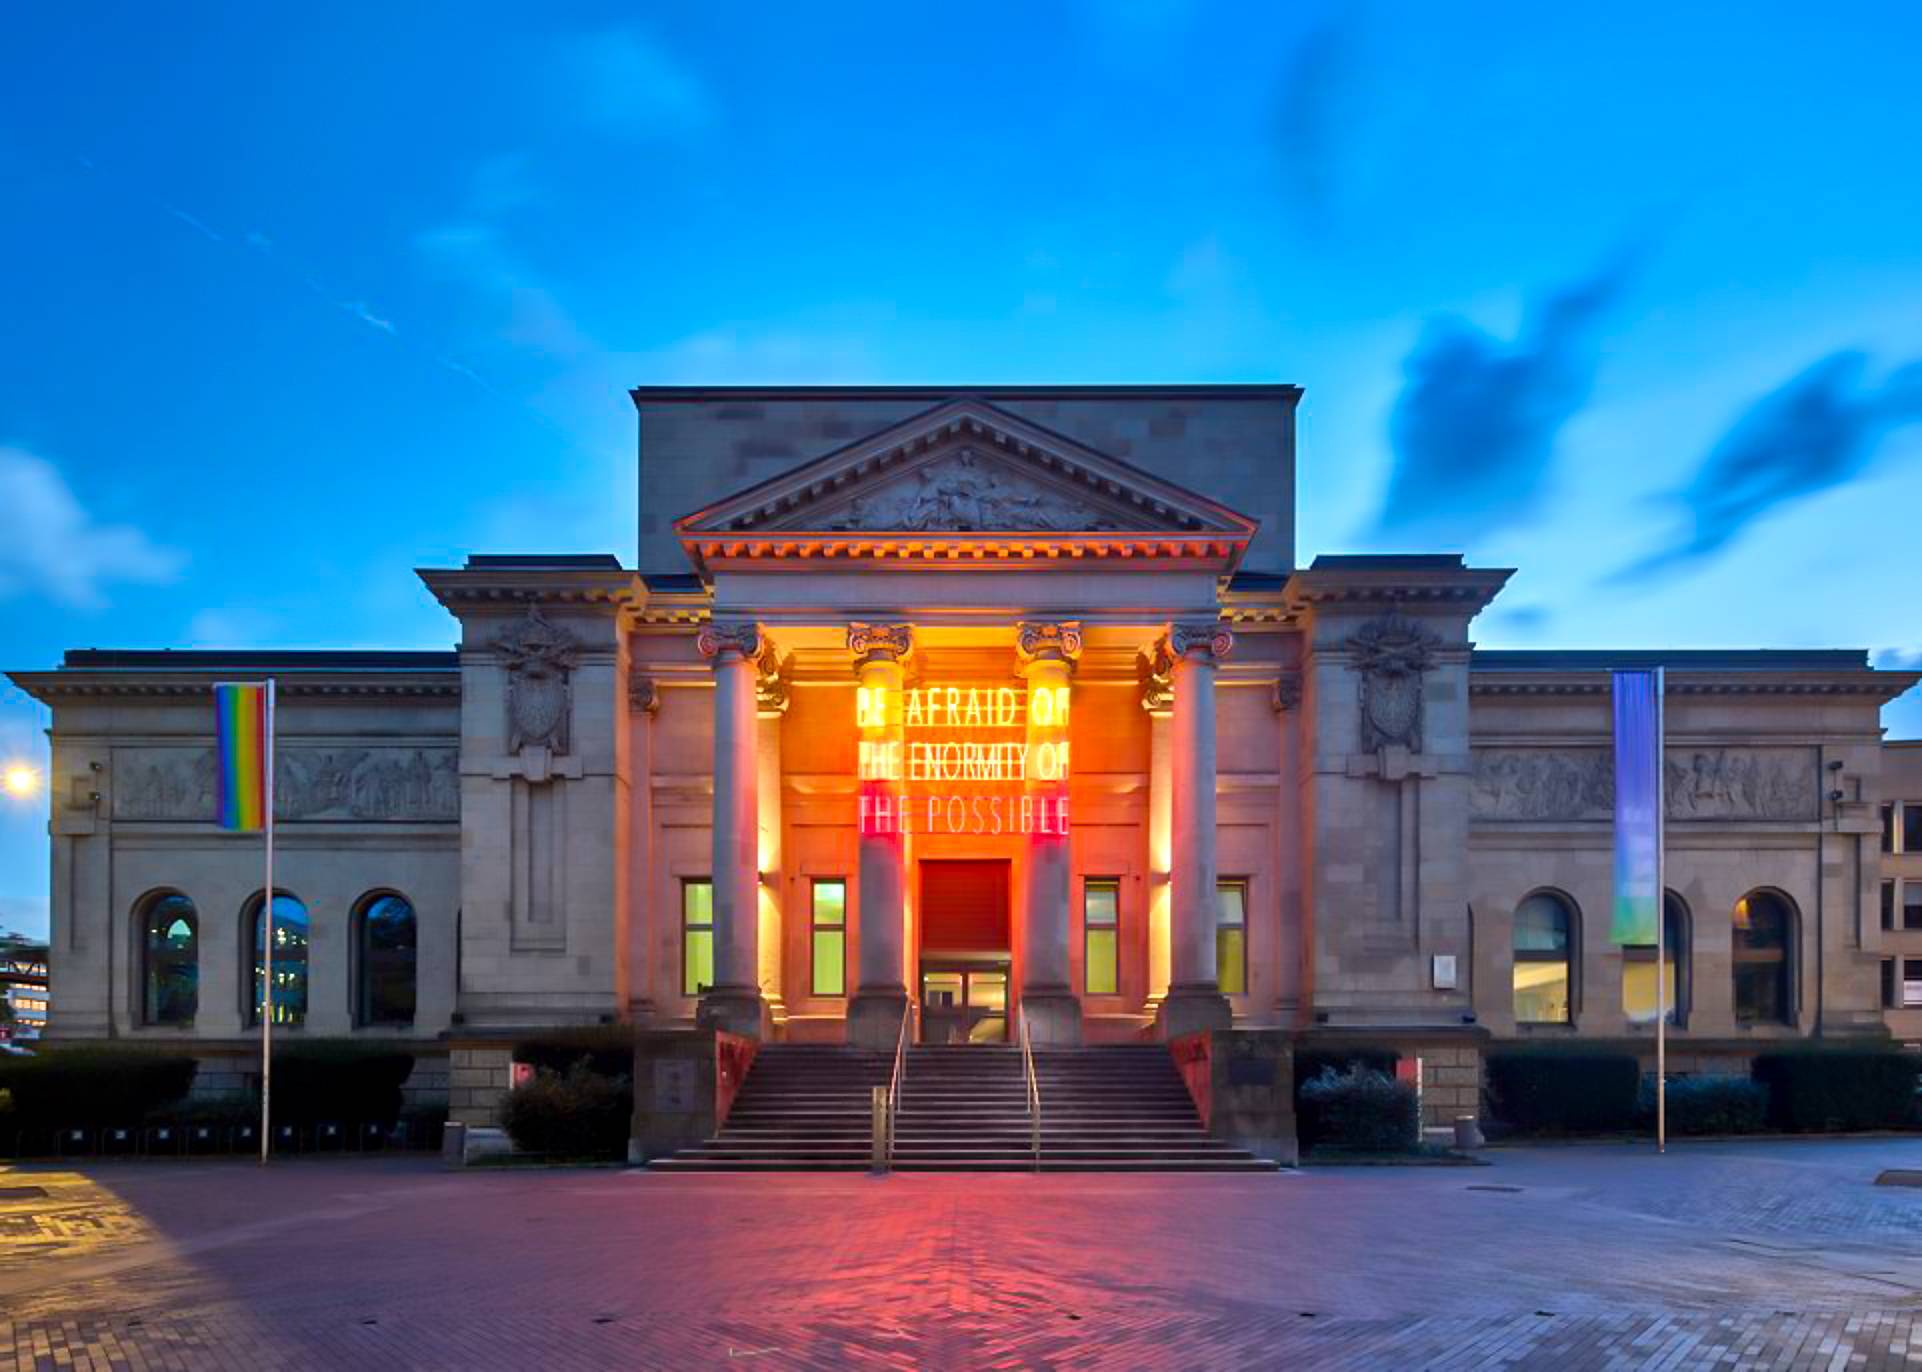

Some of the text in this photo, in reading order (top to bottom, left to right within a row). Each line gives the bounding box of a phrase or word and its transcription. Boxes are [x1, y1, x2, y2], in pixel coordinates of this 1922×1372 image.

[856, 687, 885, 727] BE
[907, 687, 1016, 727] AFRAID
[858, 741, 900, 780] THE
[910, 741, 1029, 780] ENORMITY
[859, 796, 1070, 835] THE POSSIBLE
